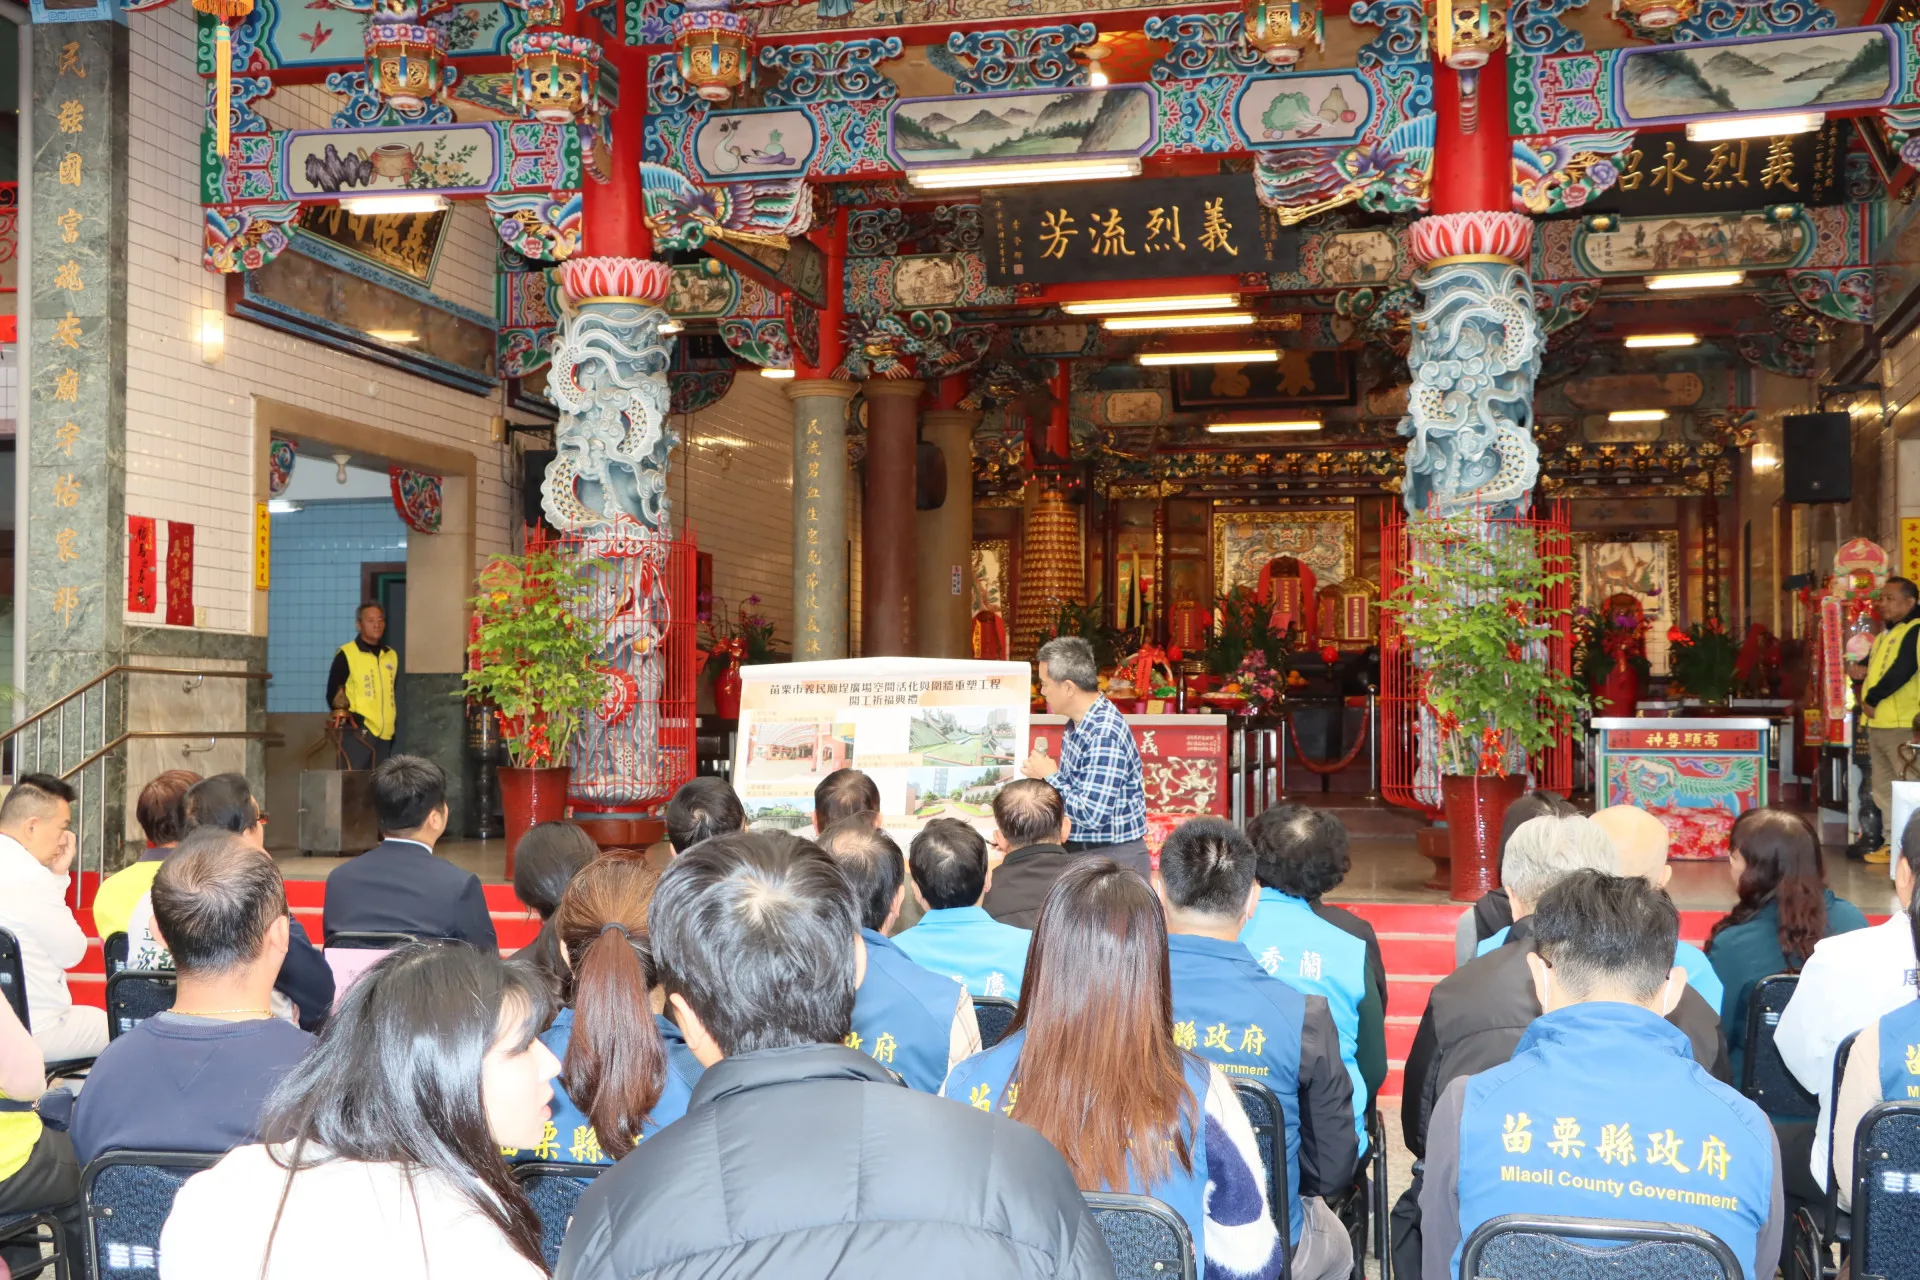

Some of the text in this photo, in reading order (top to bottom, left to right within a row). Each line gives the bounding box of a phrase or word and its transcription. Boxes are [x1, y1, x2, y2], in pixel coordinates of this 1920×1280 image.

[1039, 196, 1238, 258] 義烈流芳
[1173, 1020, 1267, 1056] 縣政府
[1501, 1112, 1732, 1182] 苗栗縣政府
[1500, 1165, 1738, 1212] Miaoli County Government
